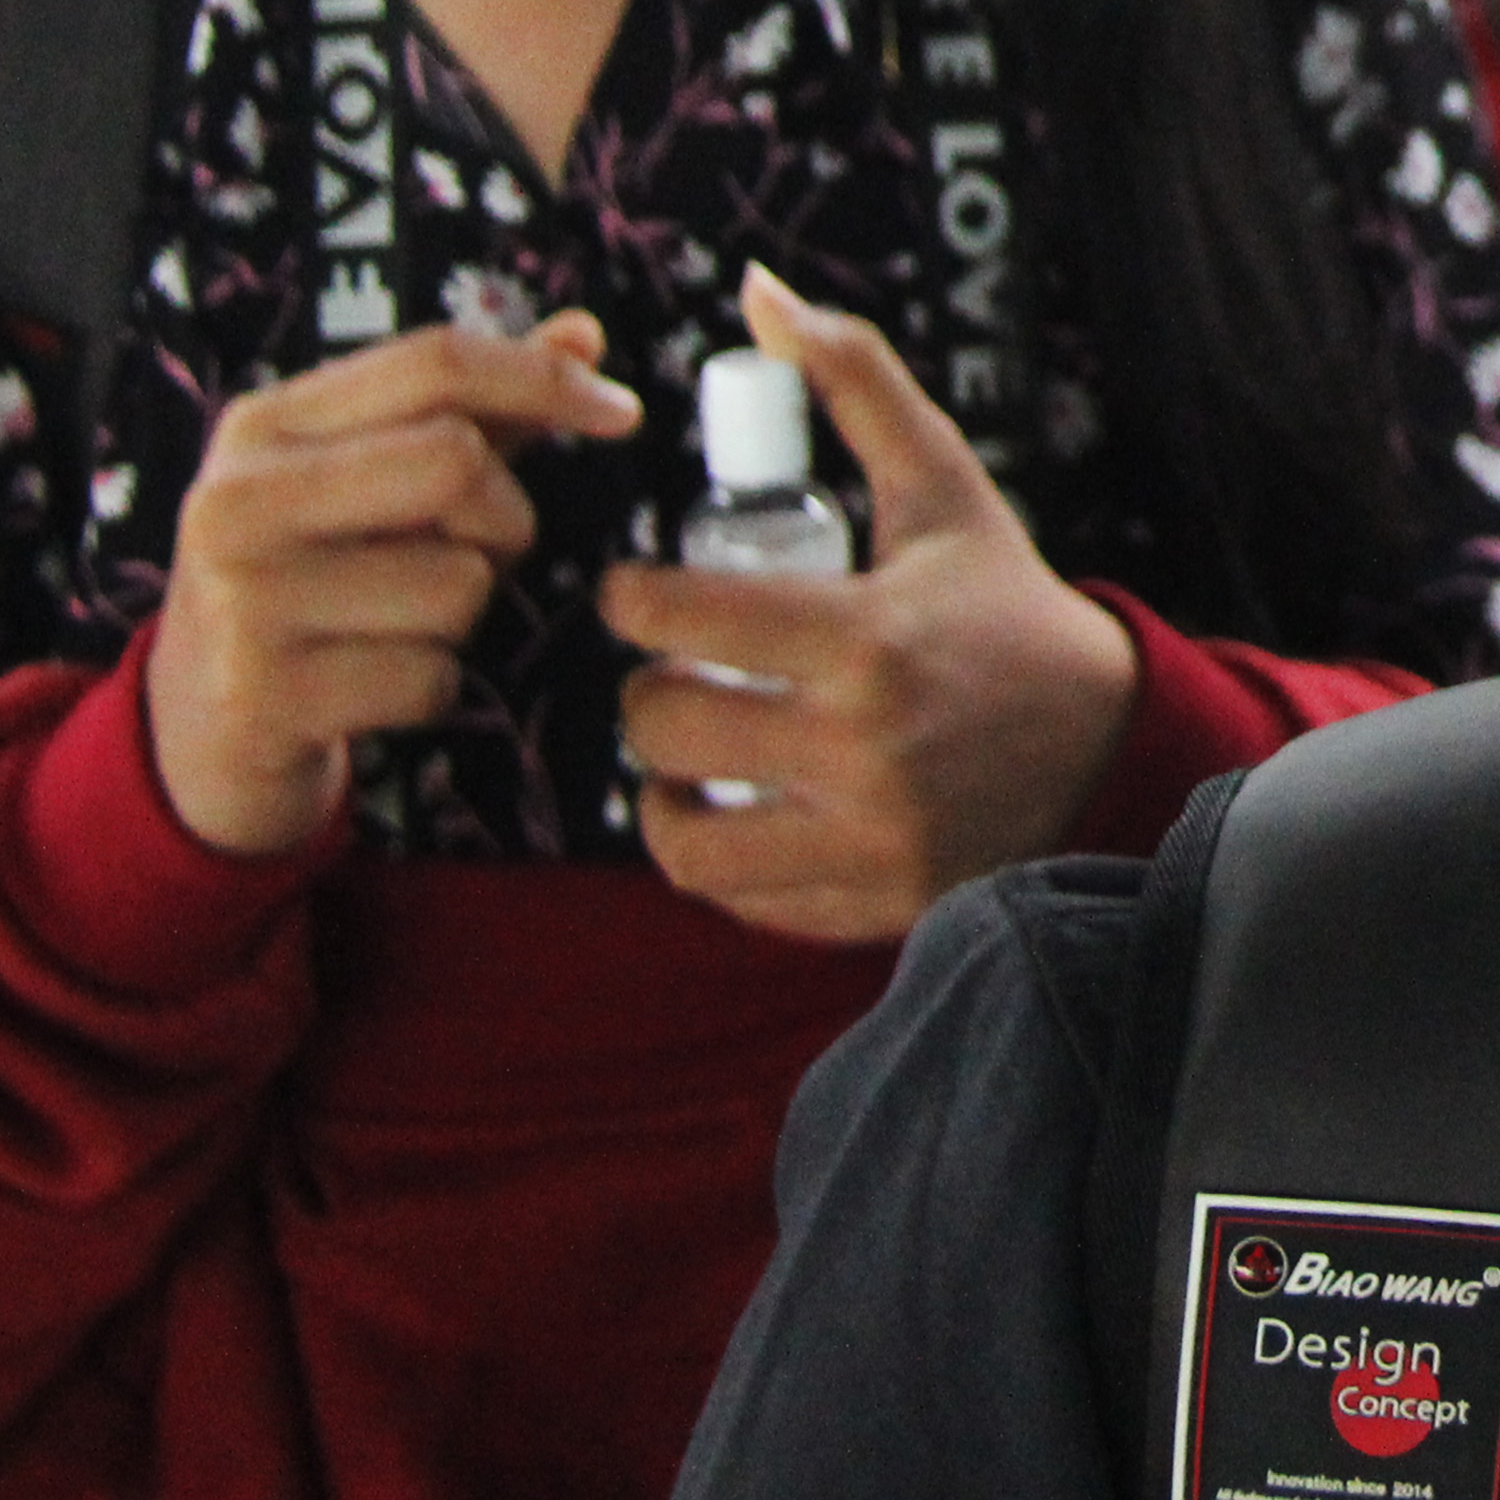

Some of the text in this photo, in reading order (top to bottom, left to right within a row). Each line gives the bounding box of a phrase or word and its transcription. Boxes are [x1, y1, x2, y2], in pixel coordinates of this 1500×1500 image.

[932, 120, 1010, 403] LOVE
[1254, 1317, 1442, 1386] Design
[1337, 1386, 1471, 1429] Concept
[1266, 1468, 1344, 1492] Innovation
[1346, 1476, 1387, 1497] since
[1392, 1480, 1434, 1500] 2014
